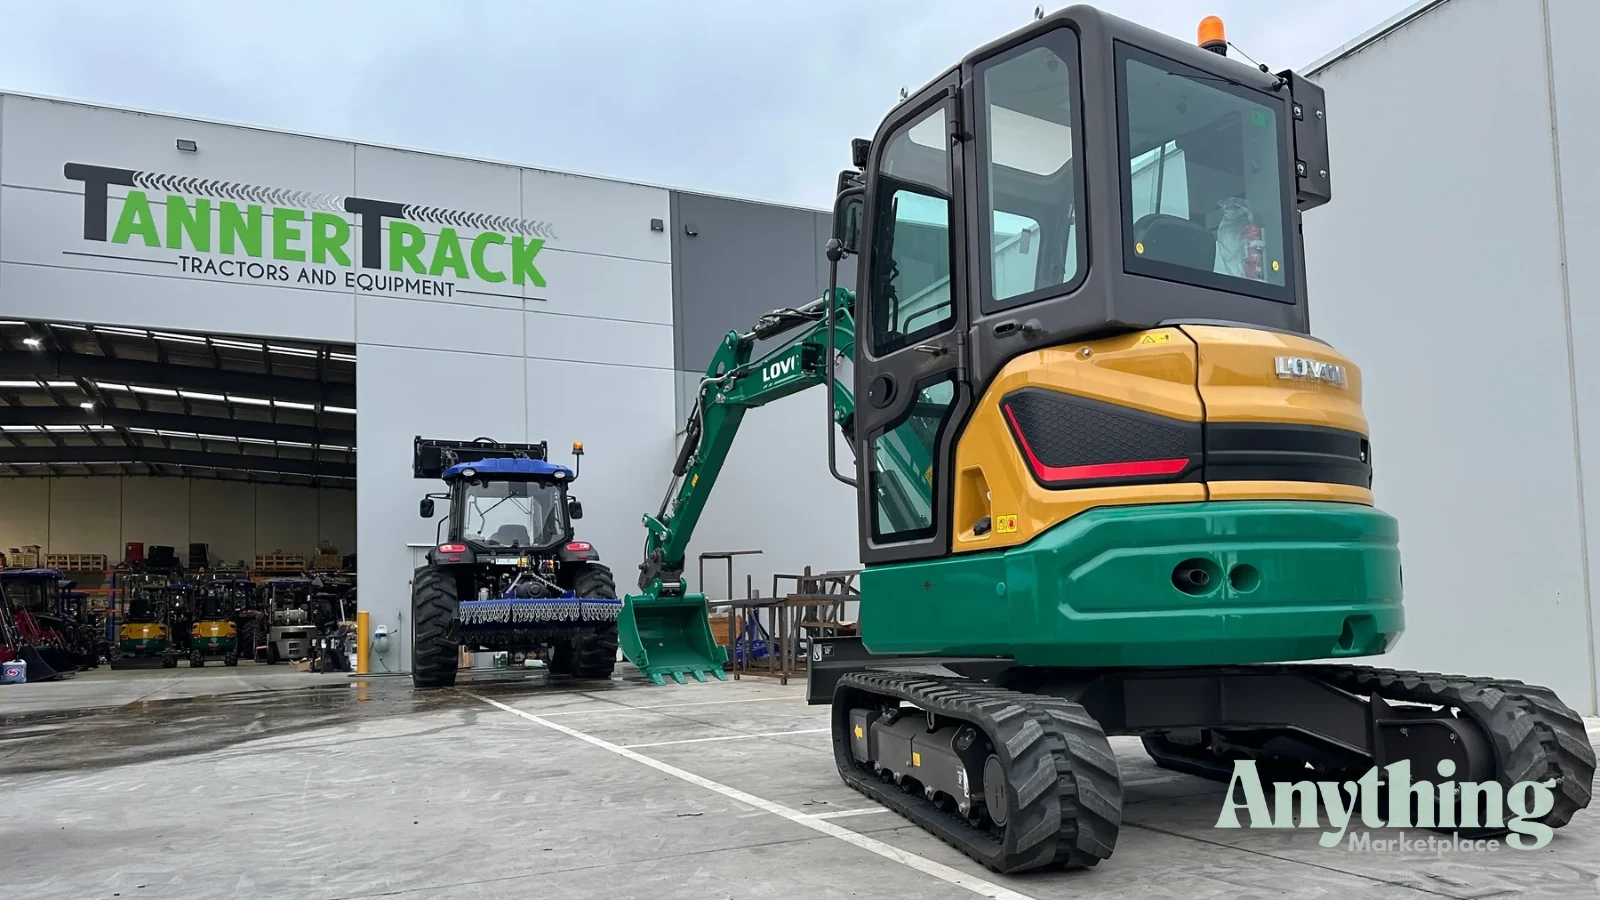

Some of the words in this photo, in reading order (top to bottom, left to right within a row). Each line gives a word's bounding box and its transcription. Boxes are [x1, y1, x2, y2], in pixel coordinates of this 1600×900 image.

[178, 255, 290, 283] TRACTORS
[297, 267, 337, 291] AND
[345, 271, 456, 299] EQUIPMENT
